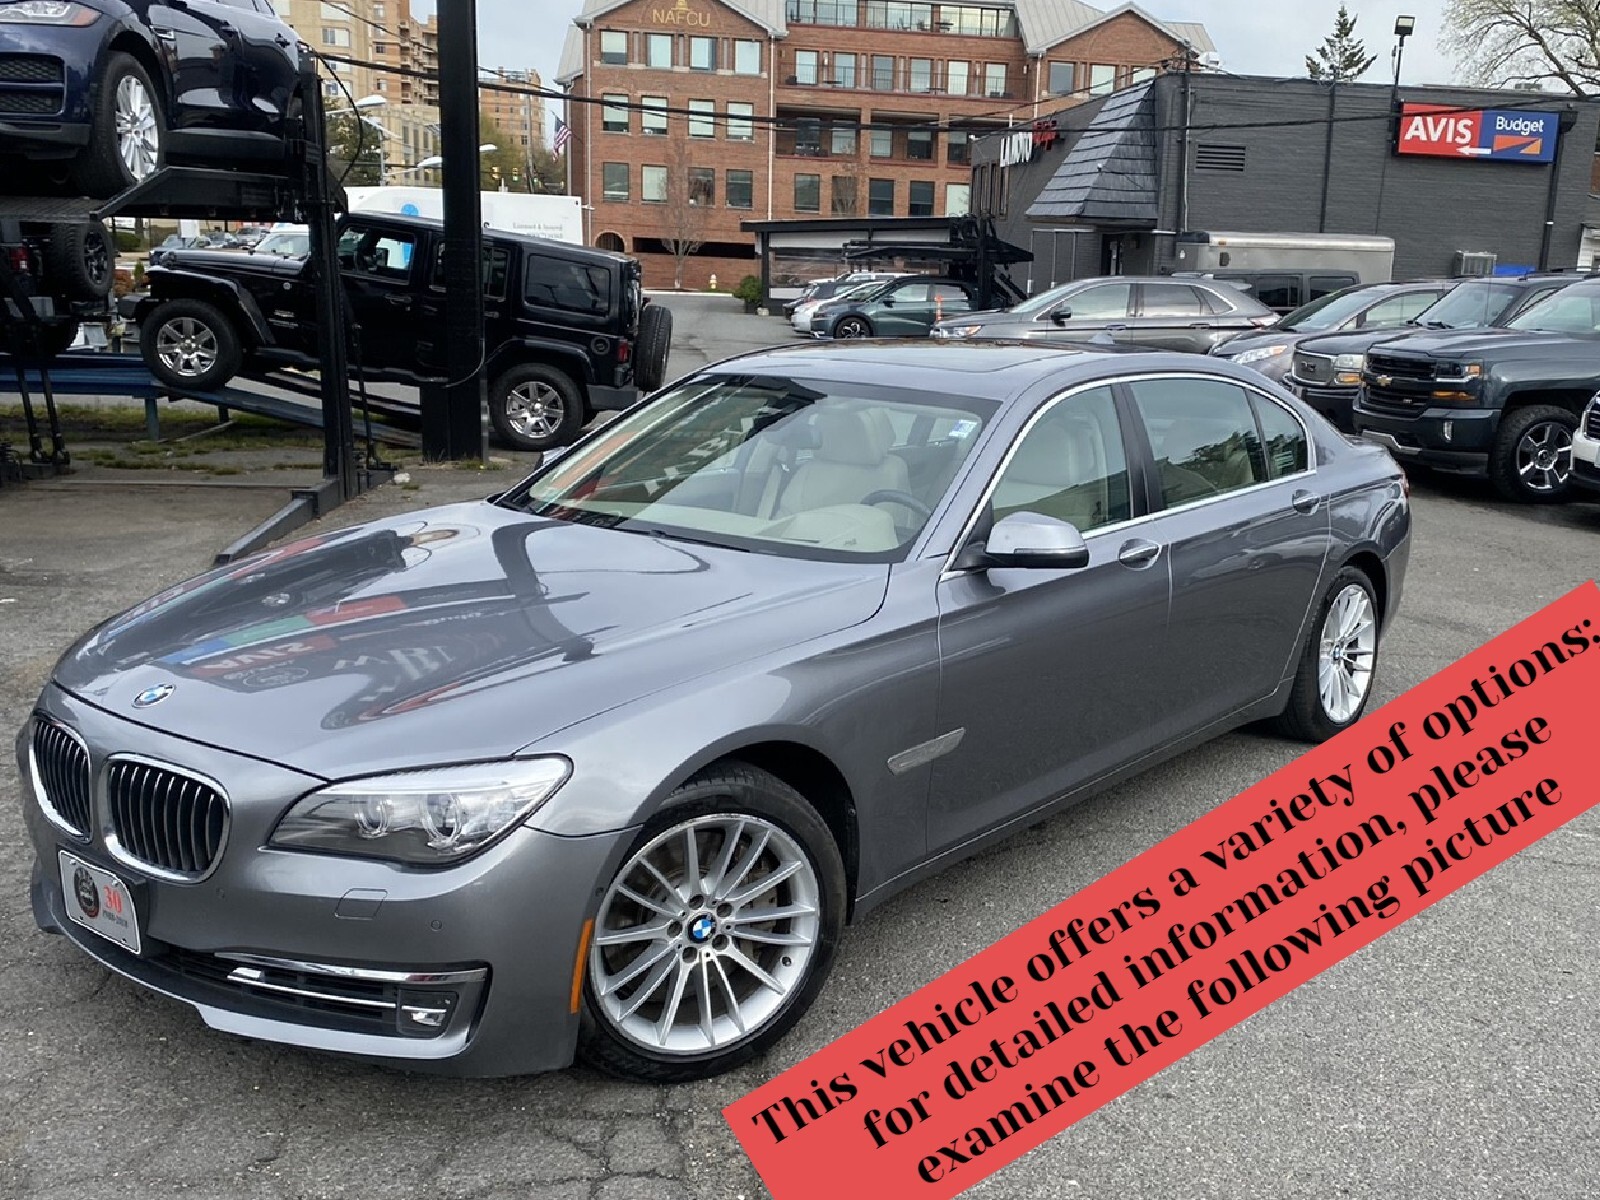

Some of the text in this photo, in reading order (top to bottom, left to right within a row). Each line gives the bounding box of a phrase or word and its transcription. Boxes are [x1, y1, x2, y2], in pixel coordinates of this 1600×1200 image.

[652, 9, 711, 27] NAFCU
[1404, 116, 1473, 144] AVIS
[1496, 116, 1544, 135] Budget
